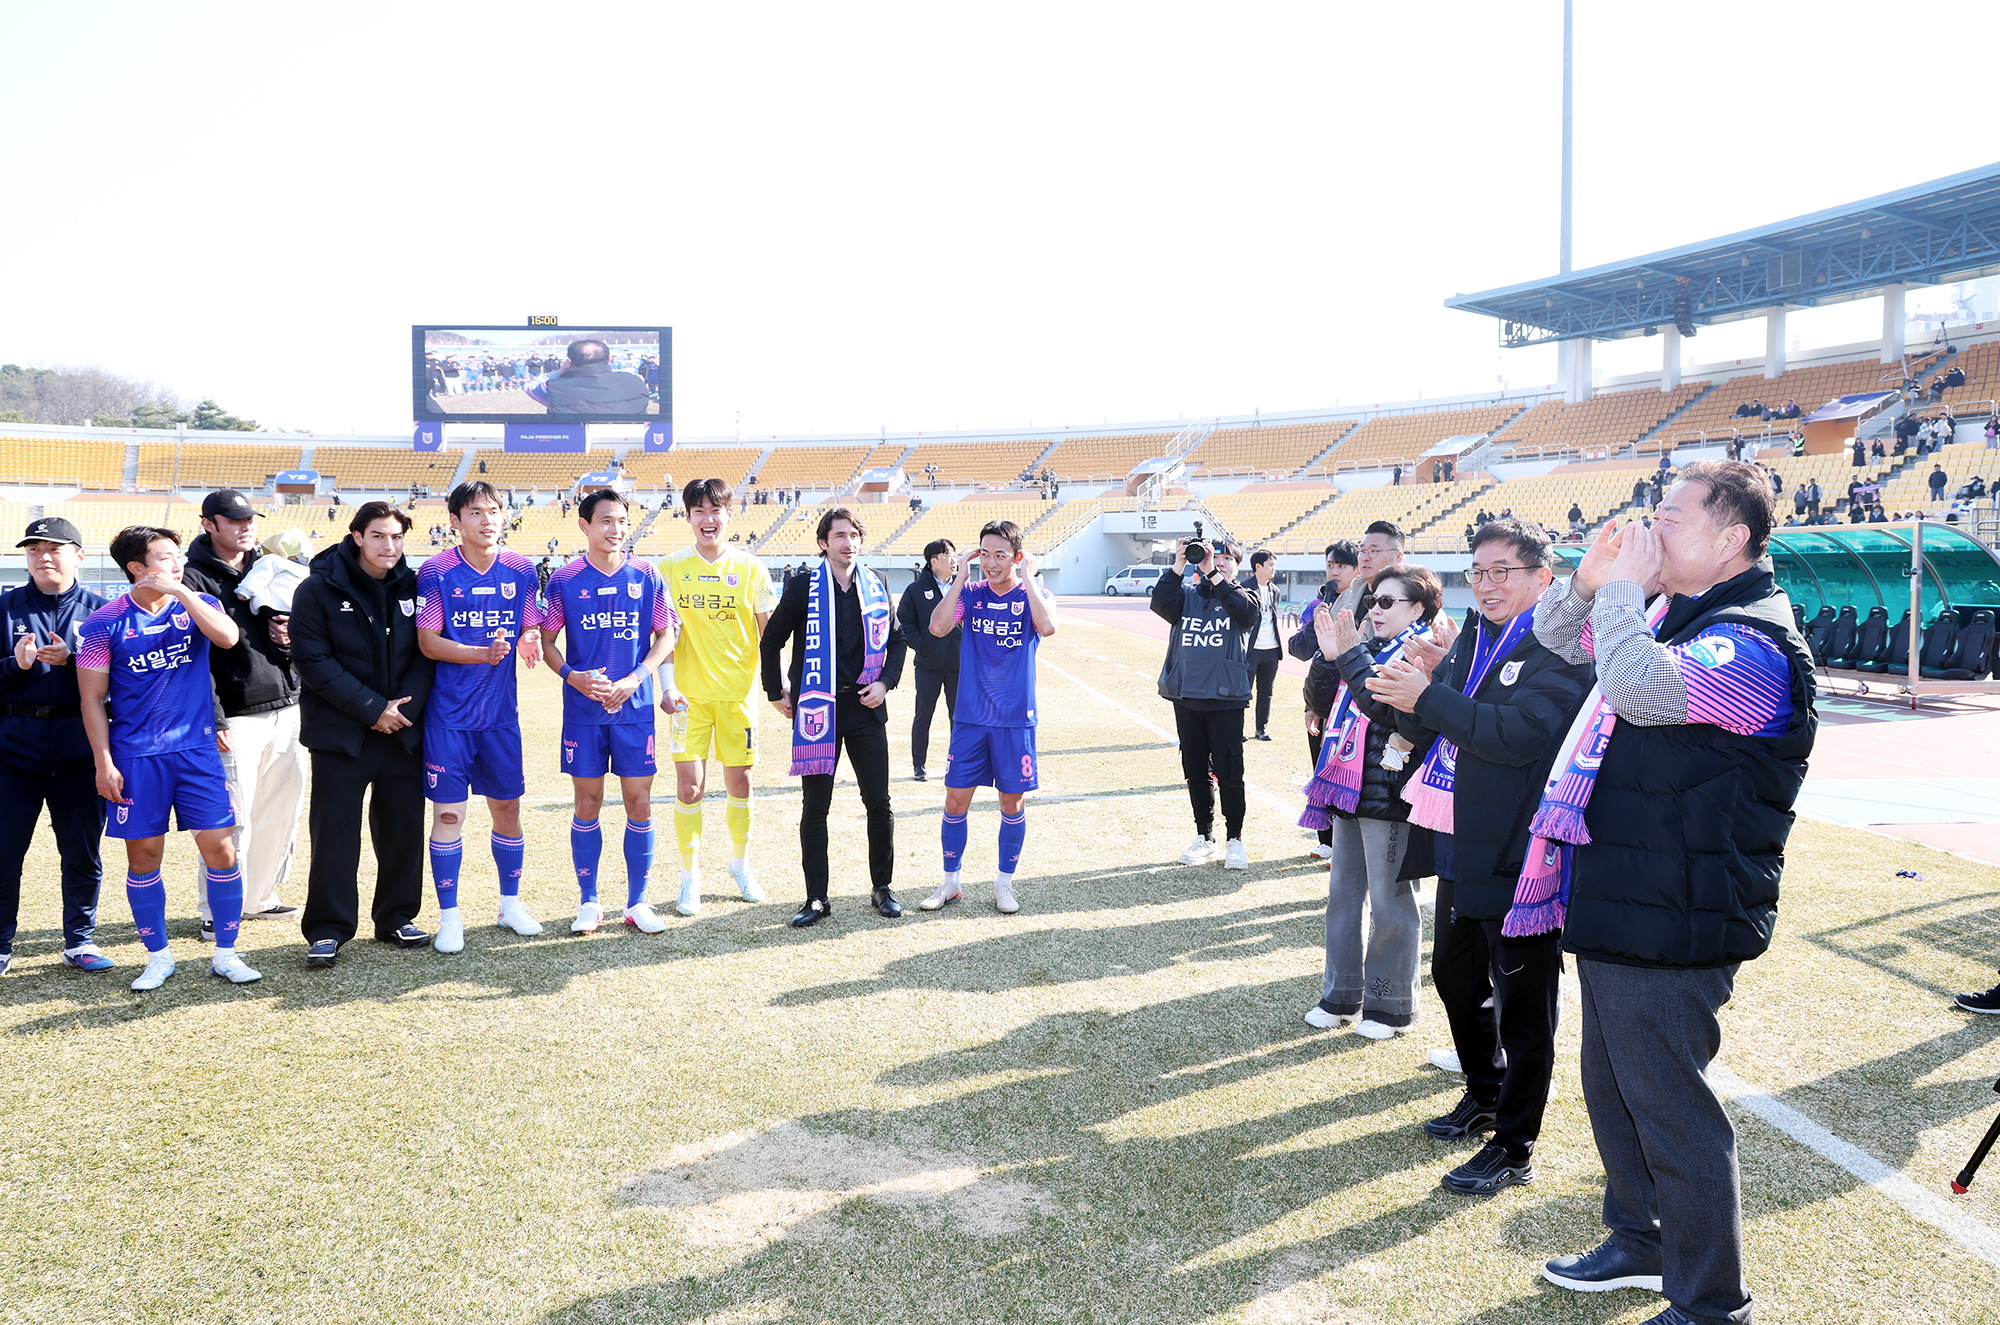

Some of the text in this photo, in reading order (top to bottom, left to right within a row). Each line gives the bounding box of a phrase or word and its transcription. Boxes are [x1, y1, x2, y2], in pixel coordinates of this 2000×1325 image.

[530, 316, 557, 325] 16:00
[1141, 515, 1158, 529] 1문
[677, 593, 736, 609] 선일금고
[451, 610, 516, 627] 선일금고
[580, 611, 640, 630] 선일금고
[971, 617, 1023, 635] 선일금고
[1181, 616, 1231, 633] TEAM
[1181, 632, 1224, 647] ENG
[806, 657, 821, 686] FC
[1020, 754, 1034, 777] 8
